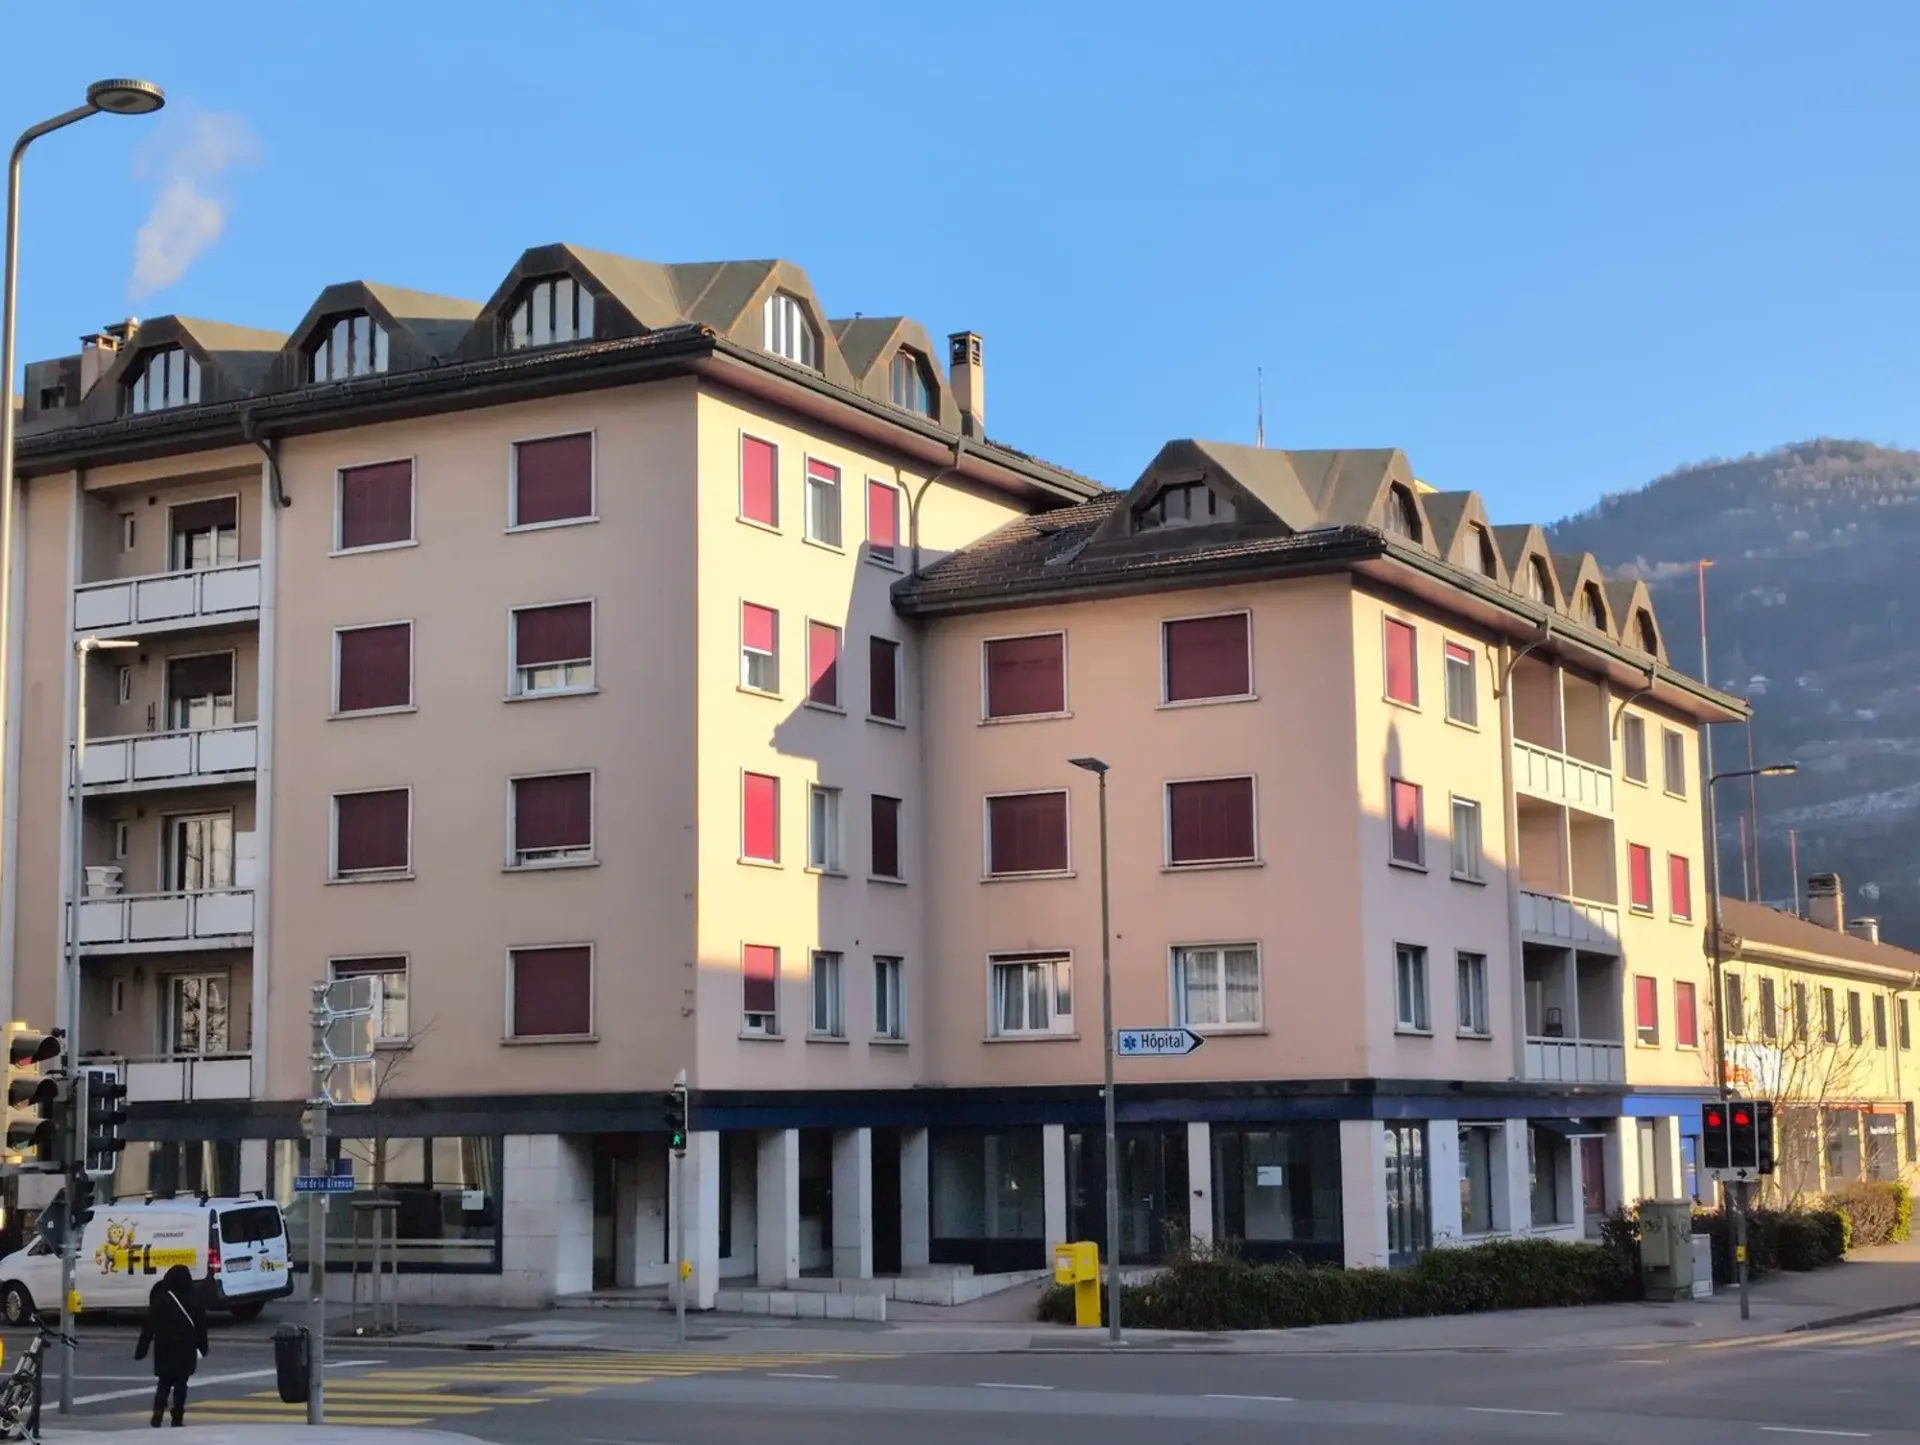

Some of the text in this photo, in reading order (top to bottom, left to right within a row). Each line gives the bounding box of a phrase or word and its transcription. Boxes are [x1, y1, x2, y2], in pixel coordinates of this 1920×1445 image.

[1141, 1032, 1184, 1052] Hôpital
[296, 1178, 308, 1189] Rue
[309, 1178, 317, 1189] de
[127, 1244, 157, 1275] FL
